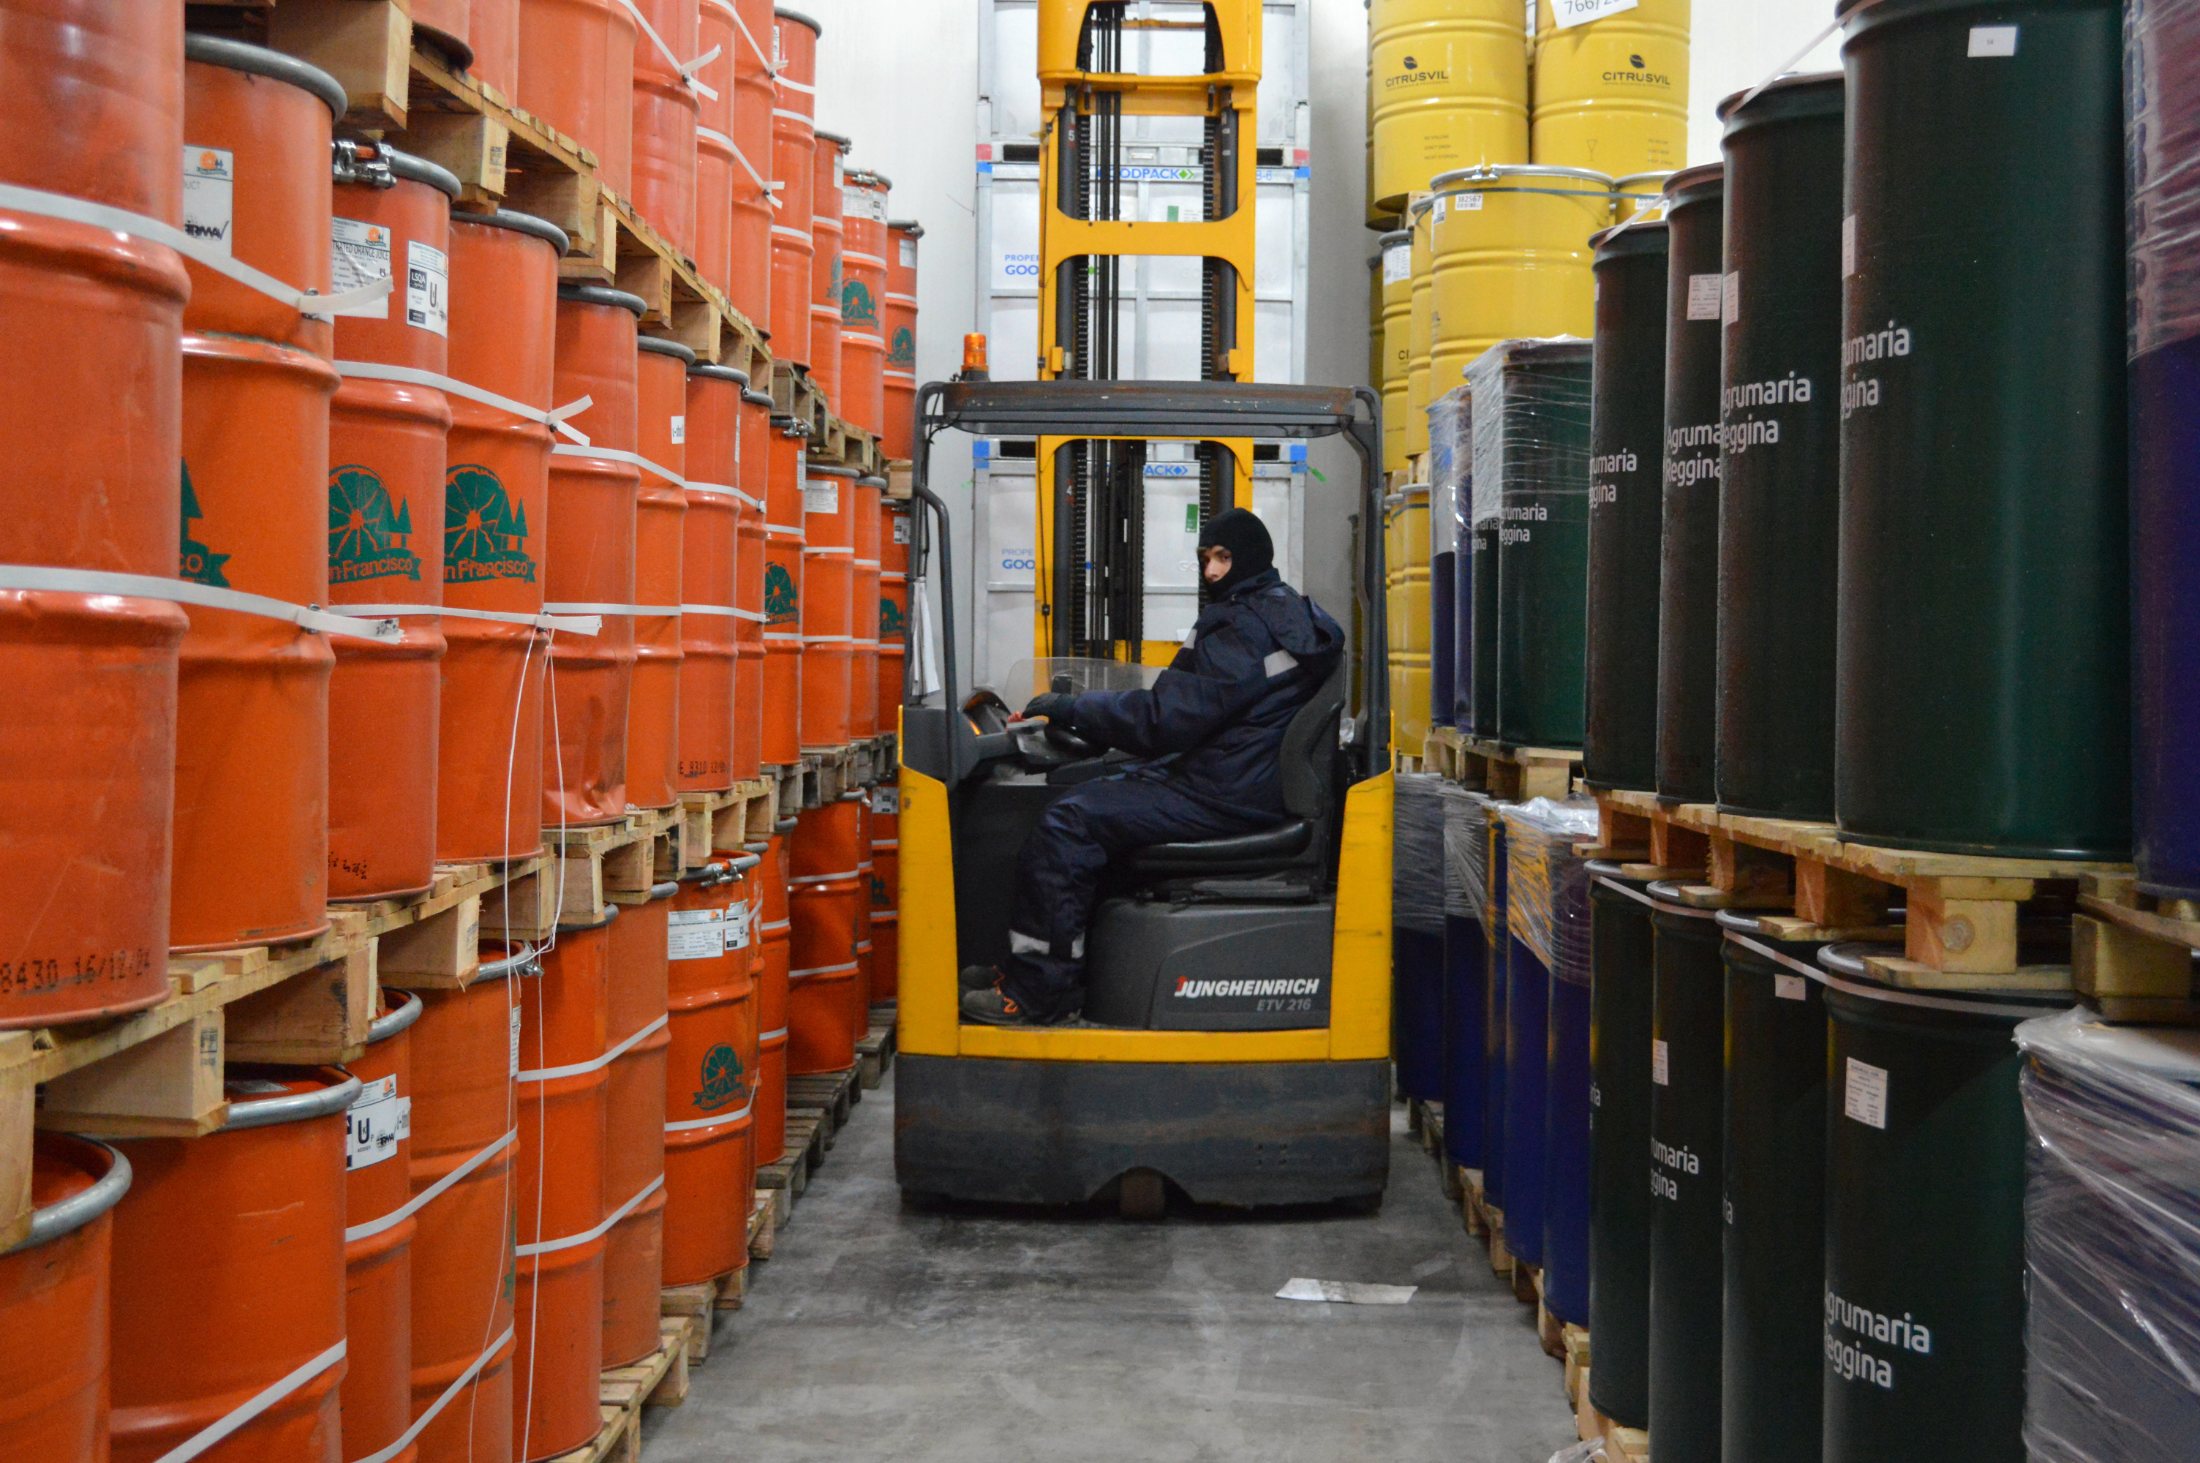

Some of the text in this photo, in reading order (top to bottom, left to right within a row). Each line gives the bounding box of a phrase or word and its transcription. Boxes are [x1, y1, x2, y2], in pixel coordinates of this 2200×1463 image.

[1385, 70, 1449, 88] CITRUSVIL
[1602, 72, 1671, 86] CITRUSVIL
[1097, 167, 1180, 179] ODPACK
[1004, 254, 1039, 262] PROPE
[1005, 264, 1039, 275] GOO
[1143, 464, 1173, 476] ACK
[342, 553, 414, 581] Francisco
[1174, 976, 1320, 998] JUNGHEINRICH
[1257, 998, 1312, 1012] ETV 216
